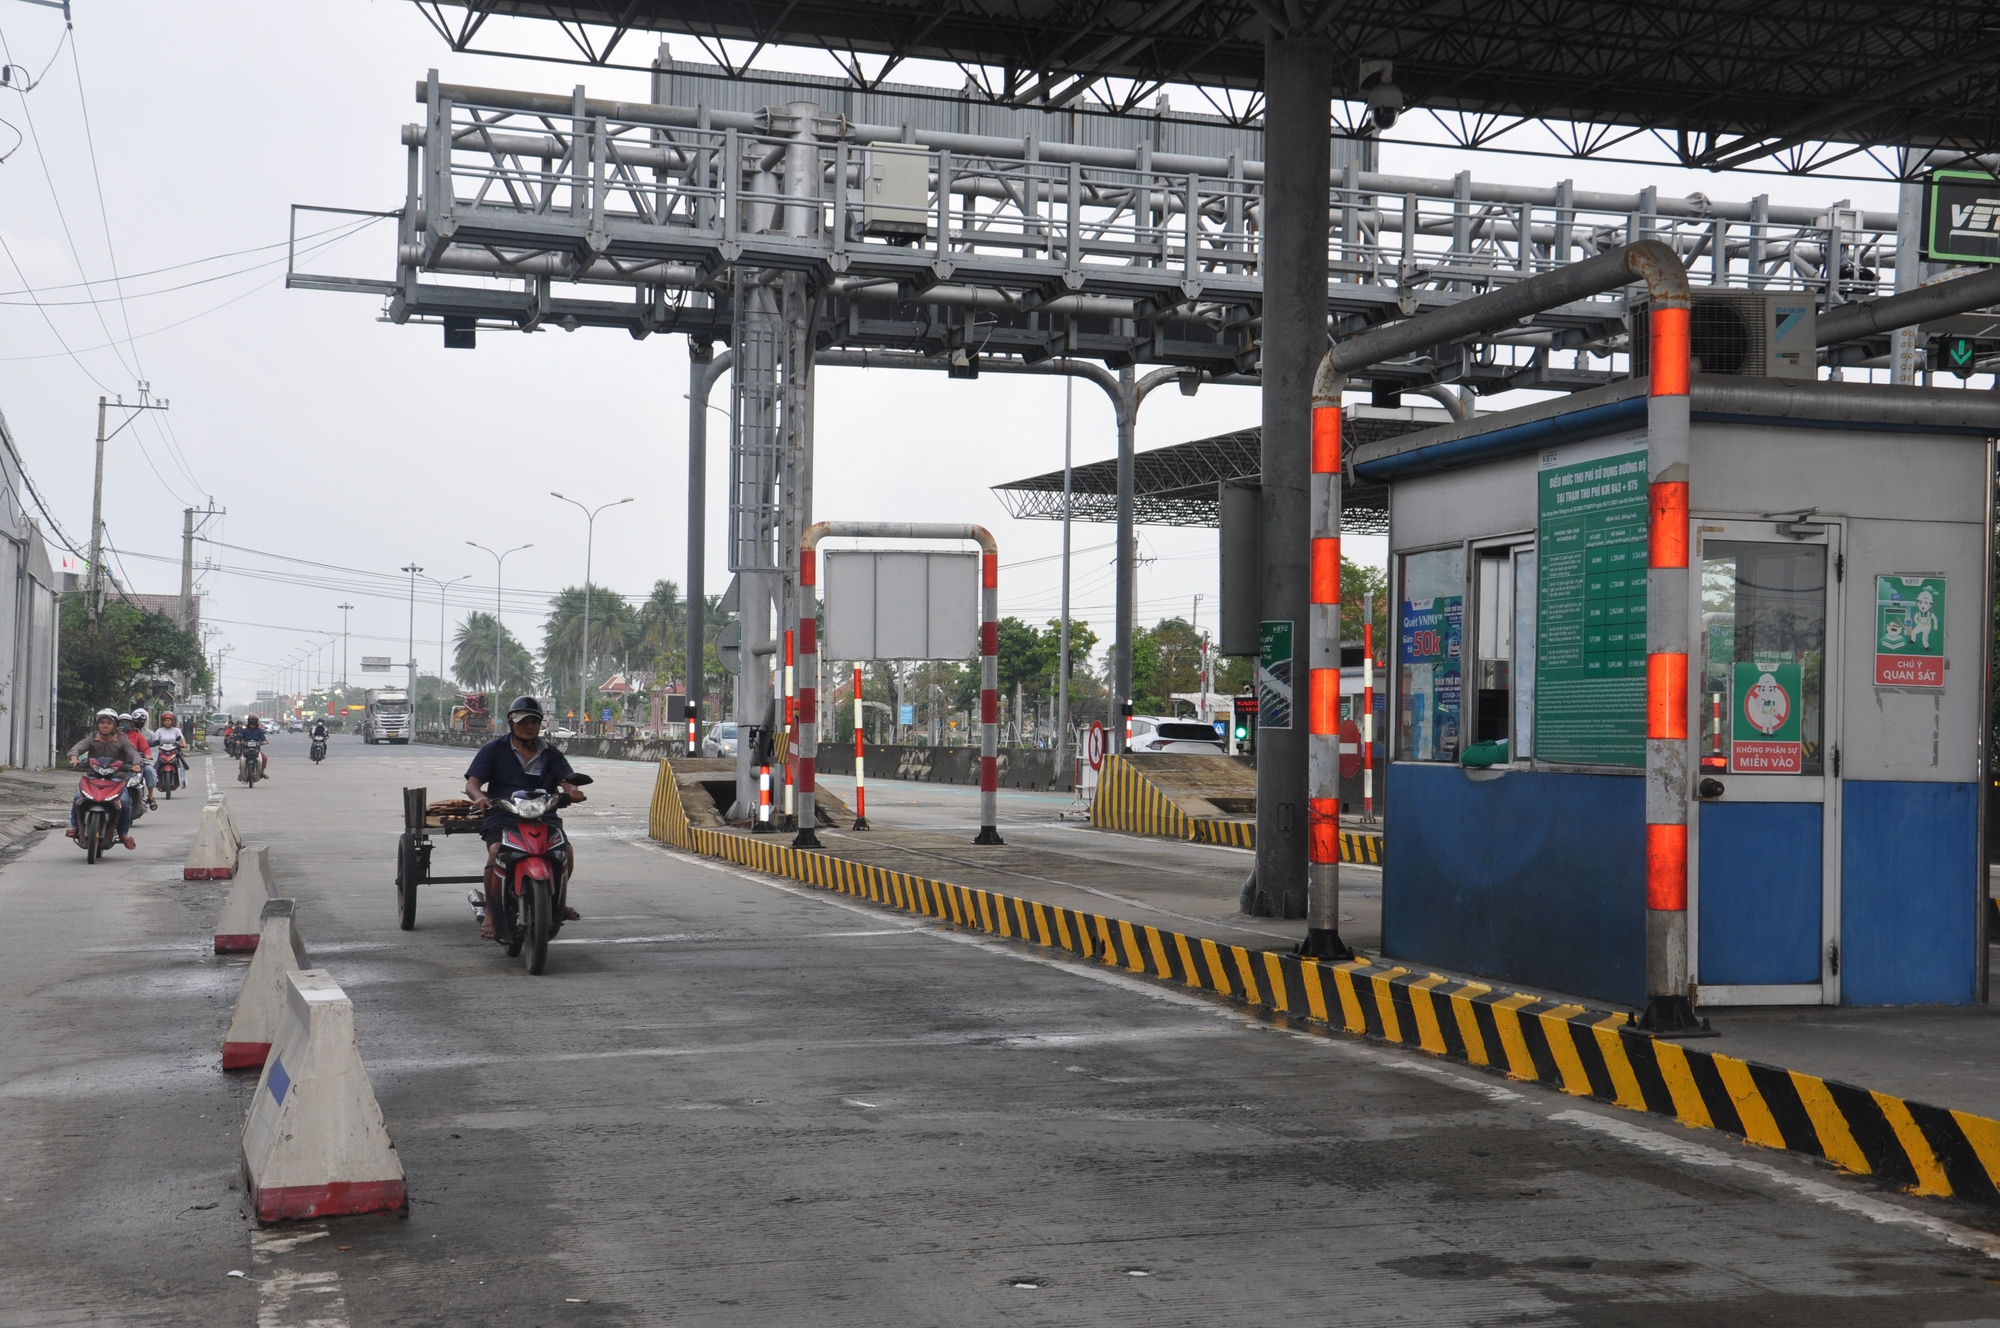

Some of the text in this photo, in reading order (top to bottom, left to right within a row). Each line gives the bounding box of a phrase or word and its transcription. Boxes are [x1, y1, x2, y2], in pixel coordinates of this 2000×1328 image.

[1574, 472, 1584, 485] THU
[1585, 468, 1594, 482] PHÍ
[1581, 488, 1590, 499] THU
[1591, 484, 1600, 498] PHÍ
[1601, 484, 1610, 496] KM
[1611, 482, 1621, 494] 943
[1628, 480, 1638, 491] 975
[1404, 616, 1418, 628] Quét
[1403, 635, 1413, 643] Giảm
[1413, 629, 1441, 657] 50k
[1897, 660, 1923, 668] CHÚ Ý
[1883, 669, 1936, 681] QUAN SÁT
[1736, 745, 1798, 756] KHÔNG PHẬN SỰ
[1771, 756, 1794, 767] VÀO
